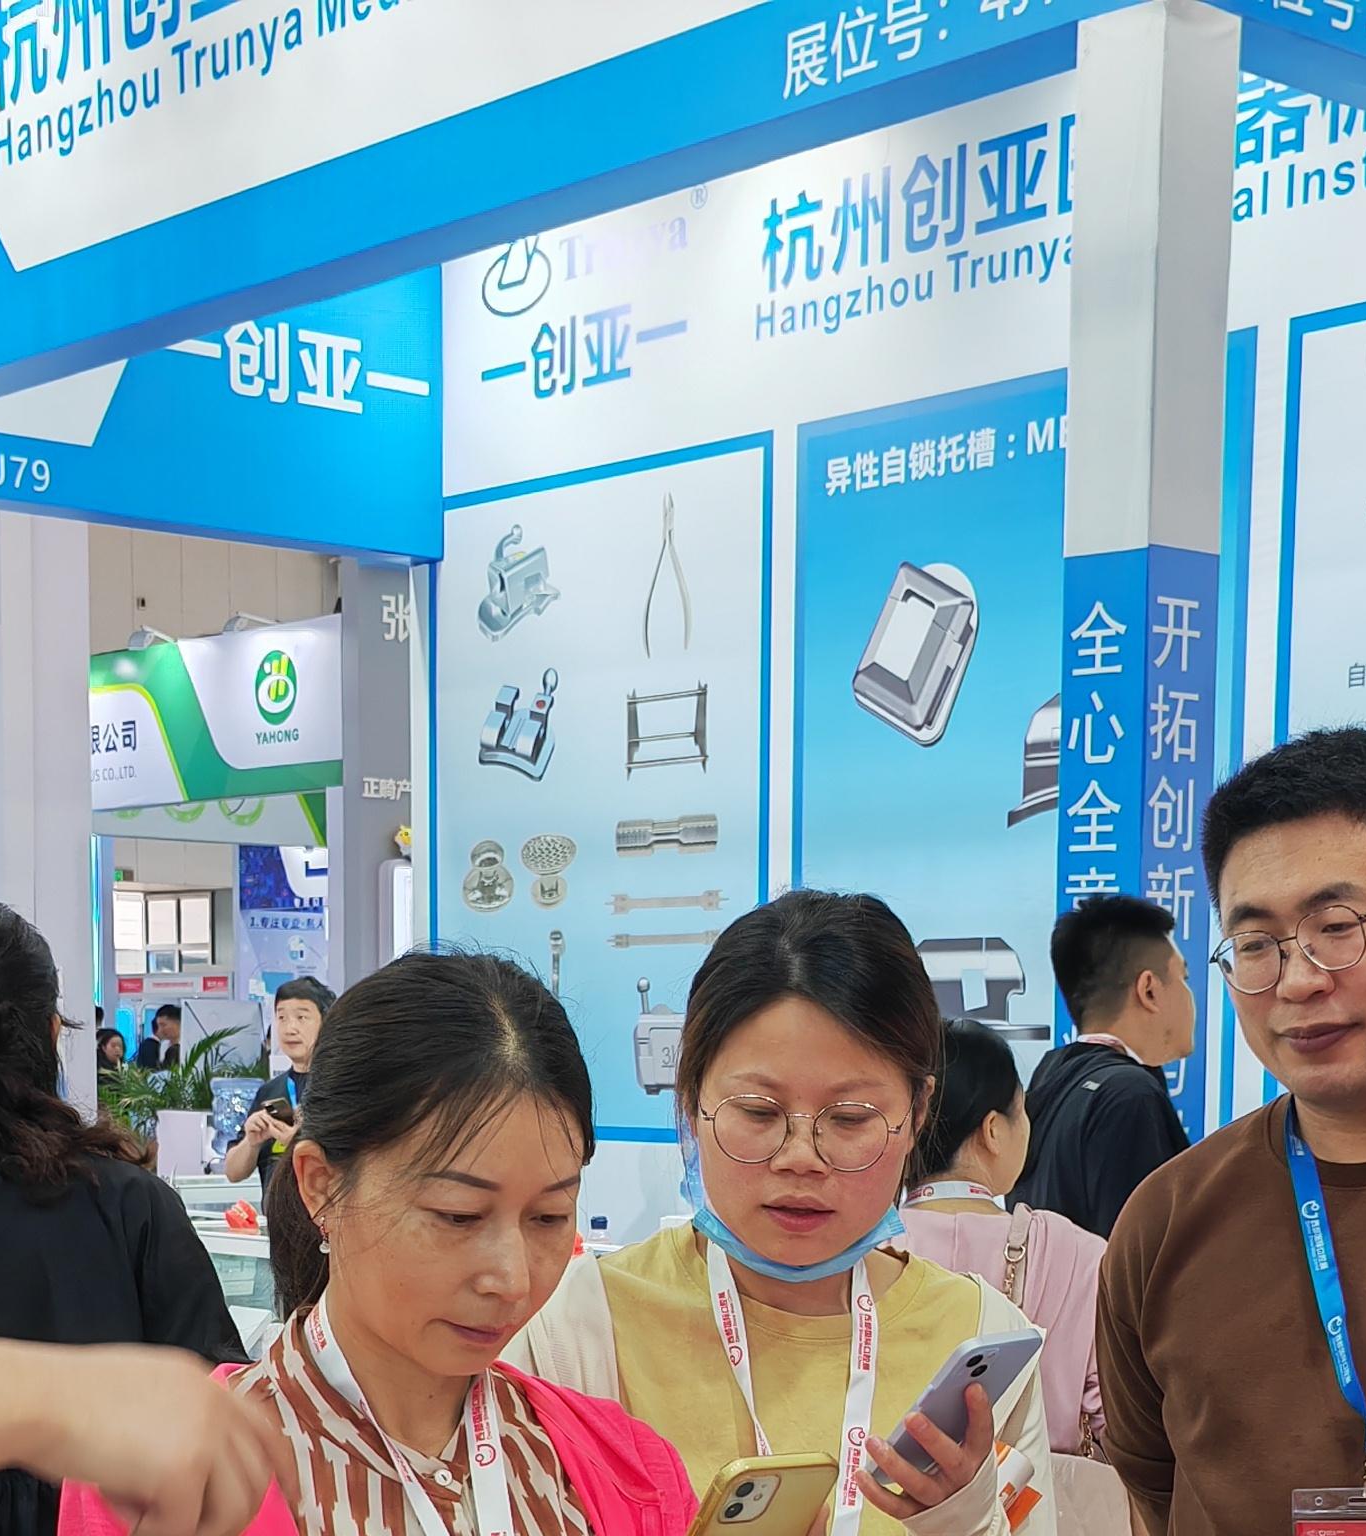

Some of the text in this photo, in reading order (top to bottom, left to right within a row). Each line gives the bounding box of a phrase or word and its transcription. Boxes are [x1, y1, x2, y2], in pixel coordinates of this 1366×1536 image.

[172, 8, 302, 94] Trunya
[754, 268, 935, 342] Hangzhou
[255, 727, 300, 747] YAHONG
